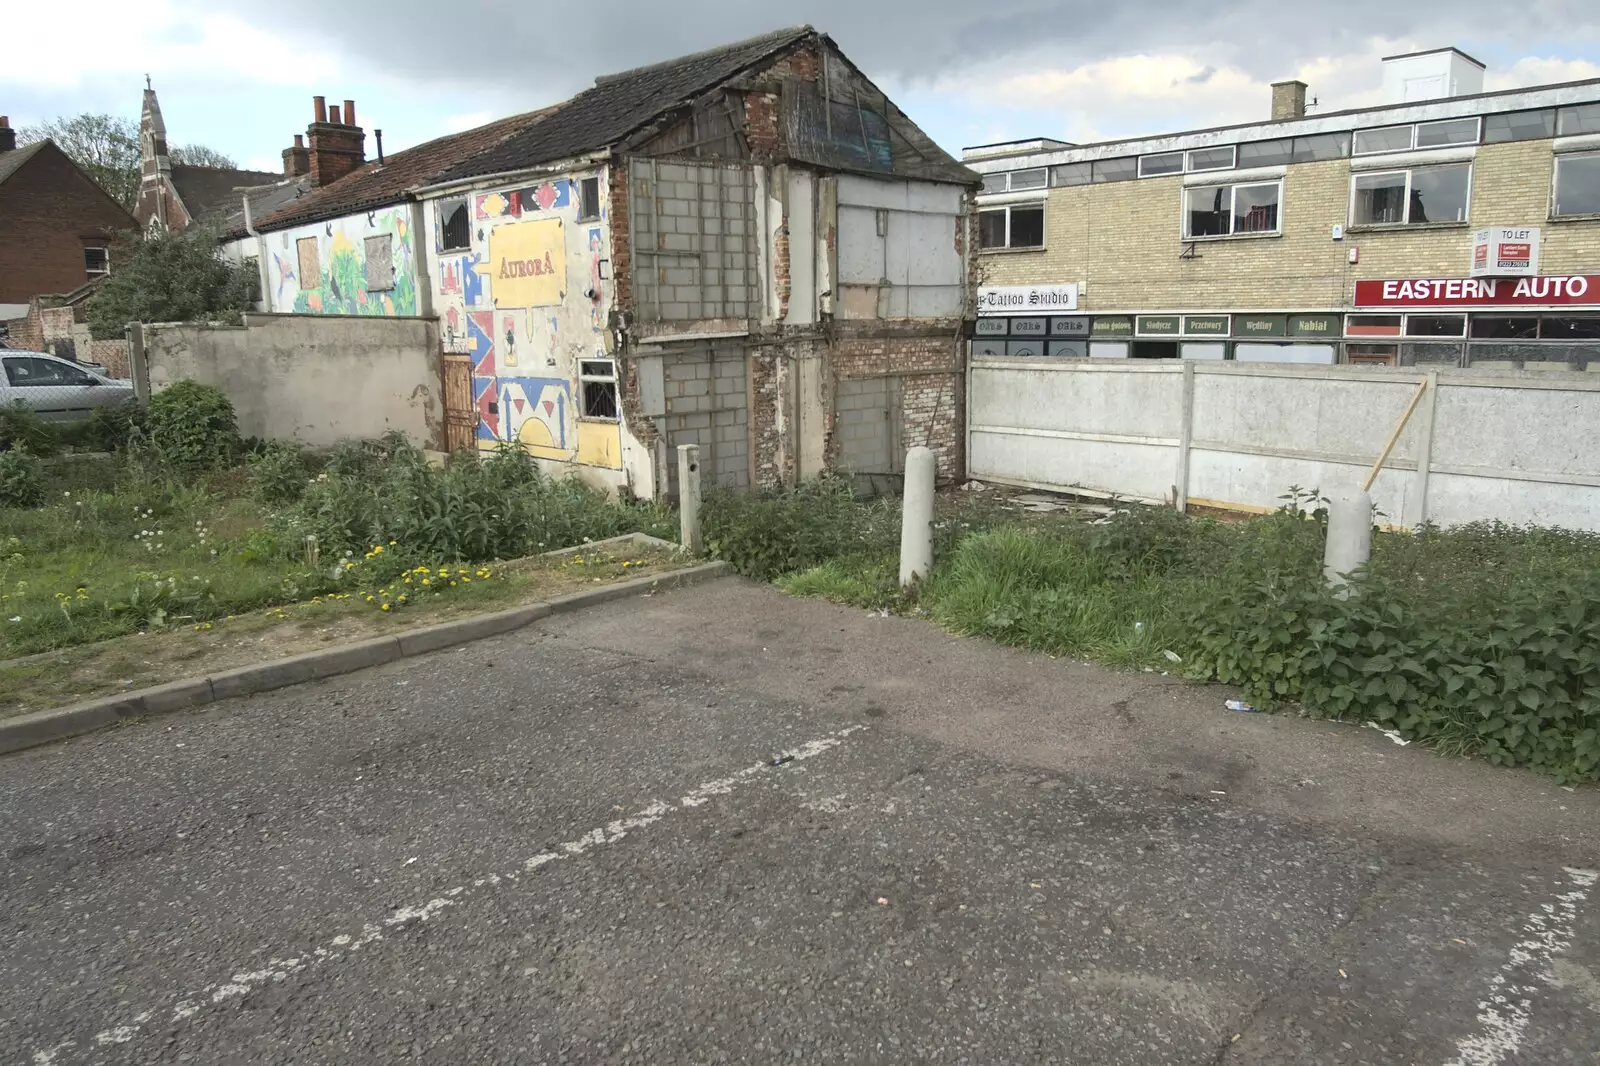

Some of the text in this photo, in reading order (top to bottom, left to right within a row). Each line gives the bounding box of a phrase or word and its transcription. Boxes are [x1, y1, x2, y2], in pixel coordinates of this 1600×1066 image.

[1502, 230, 1530, 239] TO LET
[499, 251, 555, 279] AURORA
[1382, 276, 1588, 299] EASTERN AUTO
[988, 291, 1024, 306] Tattoo
[1029, 290, 1069, 305] Studio
[1016, 322, 1041, 331] OAKS
[1056, 321, 1083, 331] OAKS
[1190, 320, 1223, 331] Przetwory
